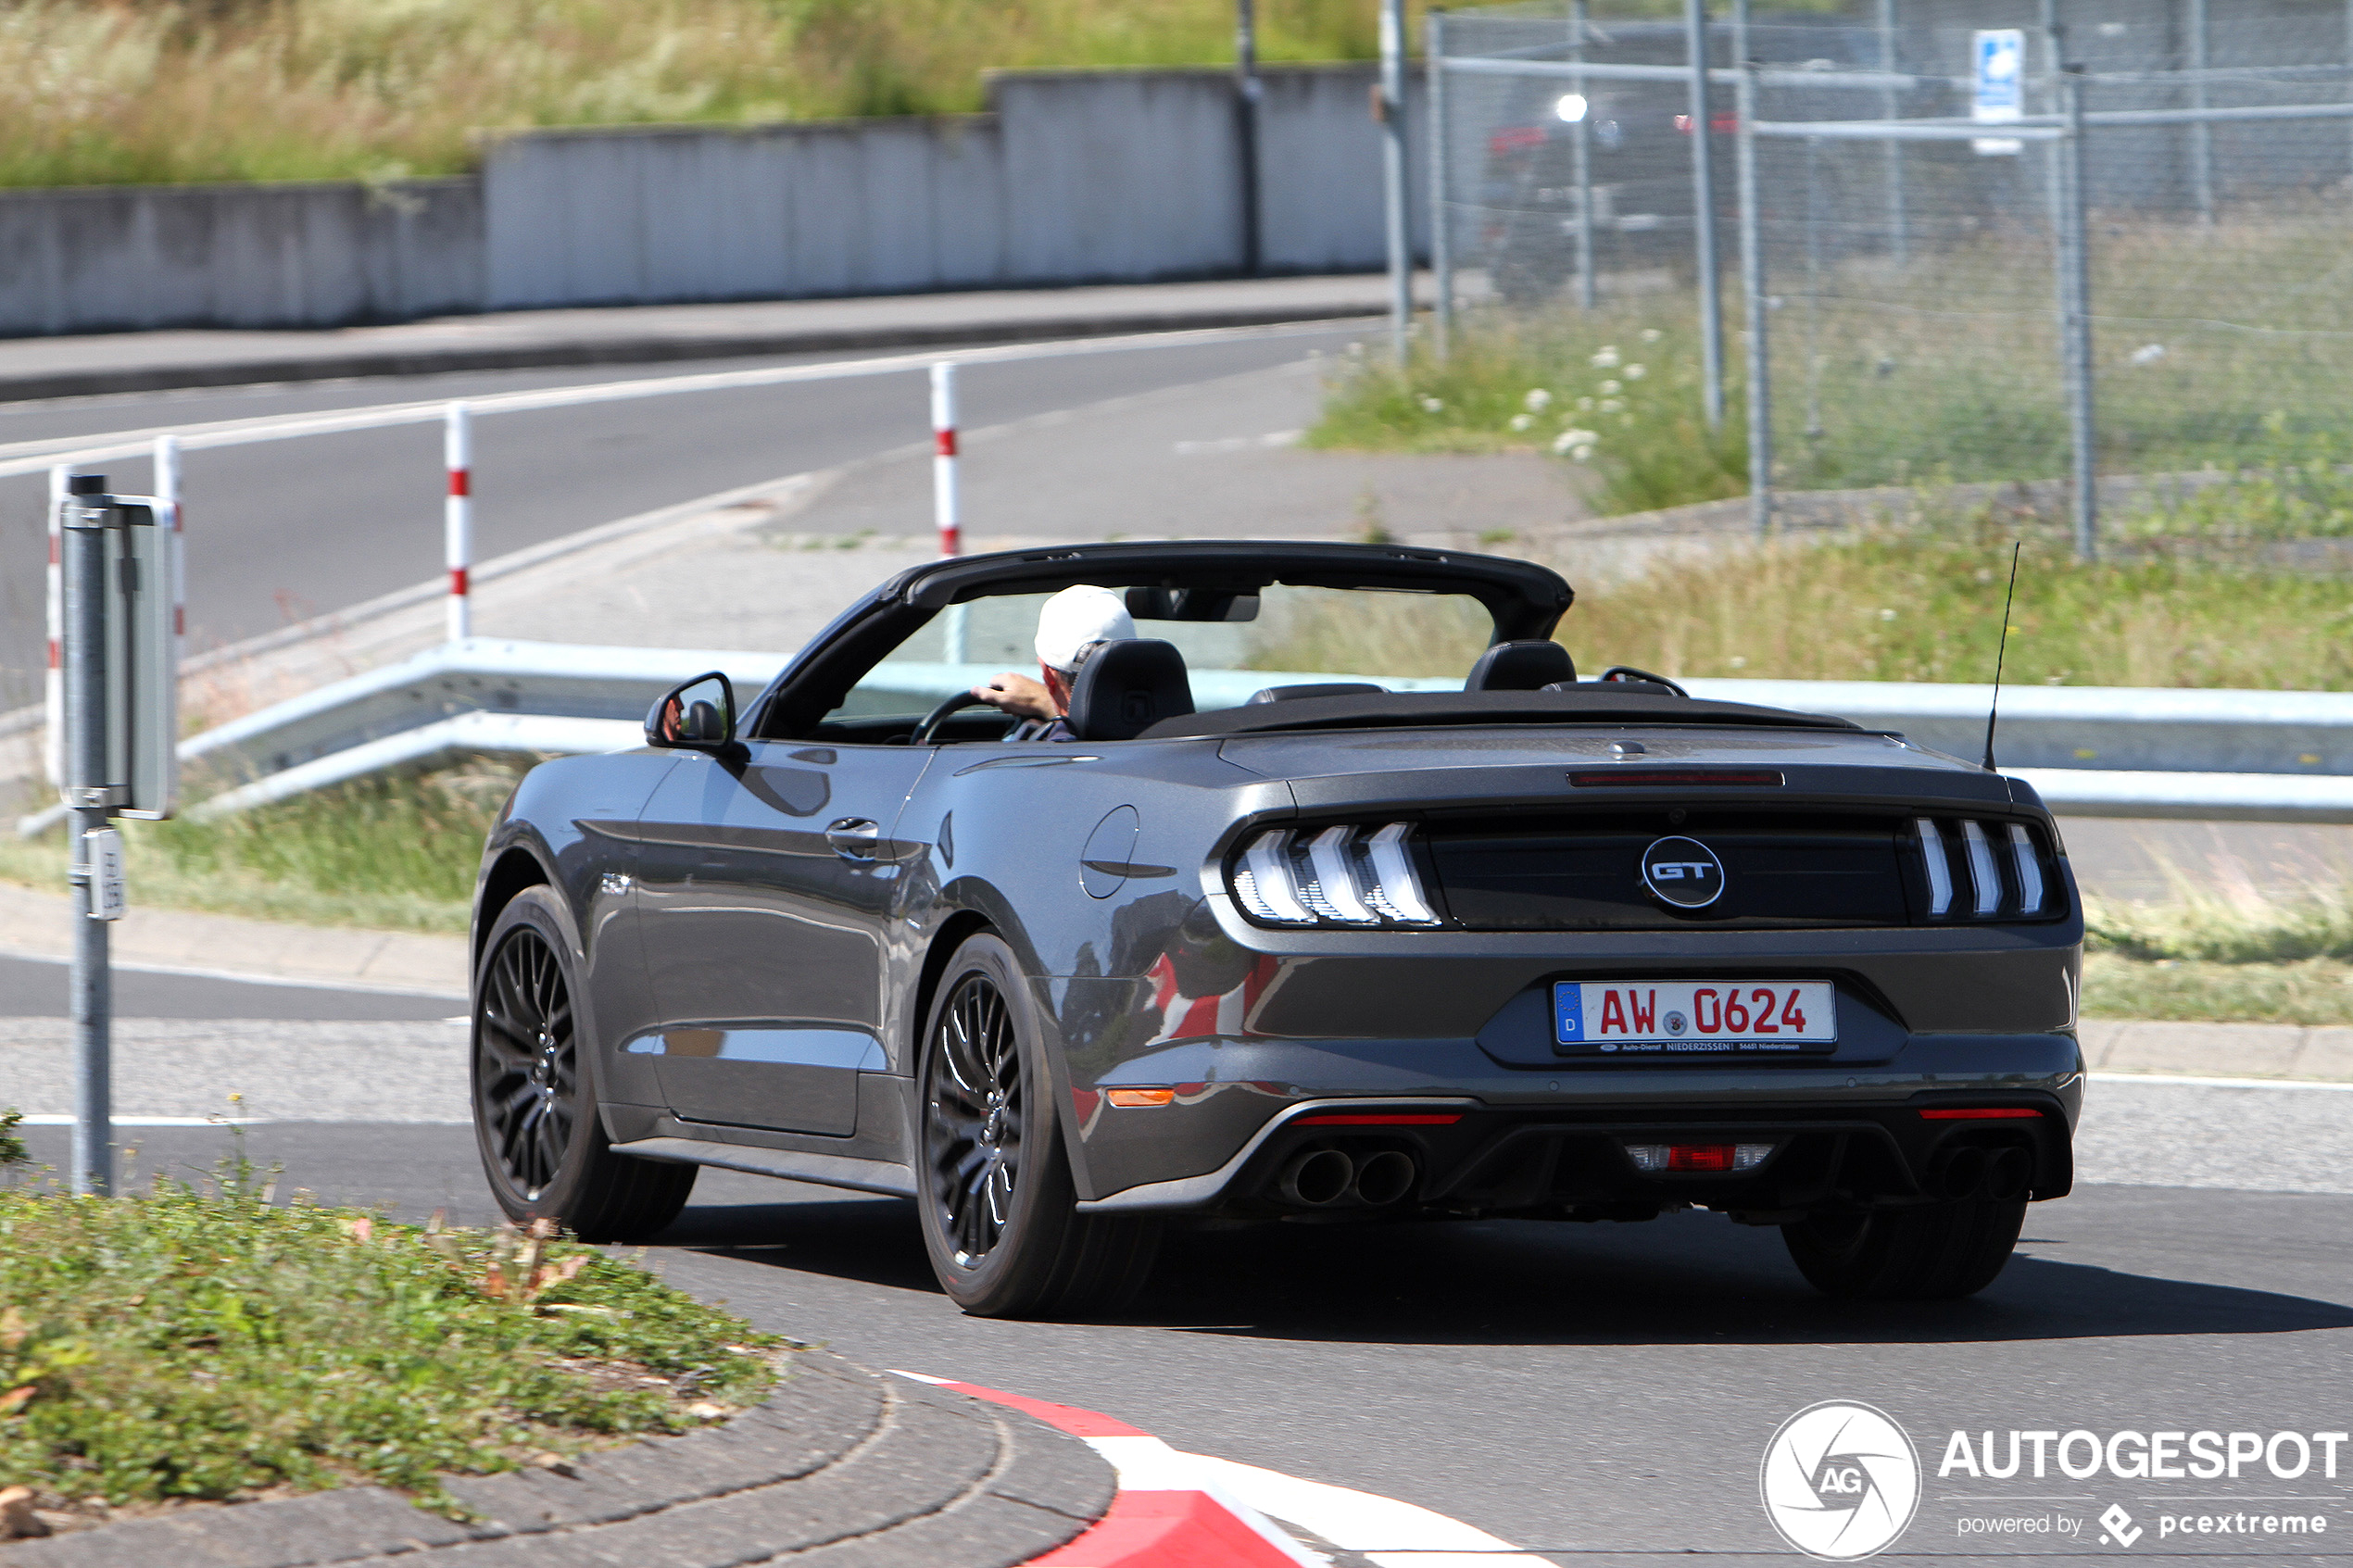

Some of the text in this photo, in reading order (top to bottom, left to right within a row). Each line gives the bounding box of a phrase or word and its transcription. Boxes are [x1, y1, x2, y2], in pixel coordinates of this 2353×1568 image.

[1652, 862, 1714, 880] GT
[1601, 988, 1806, 1035] AW 0624
[1566, 1018, 1576, 1032] D
